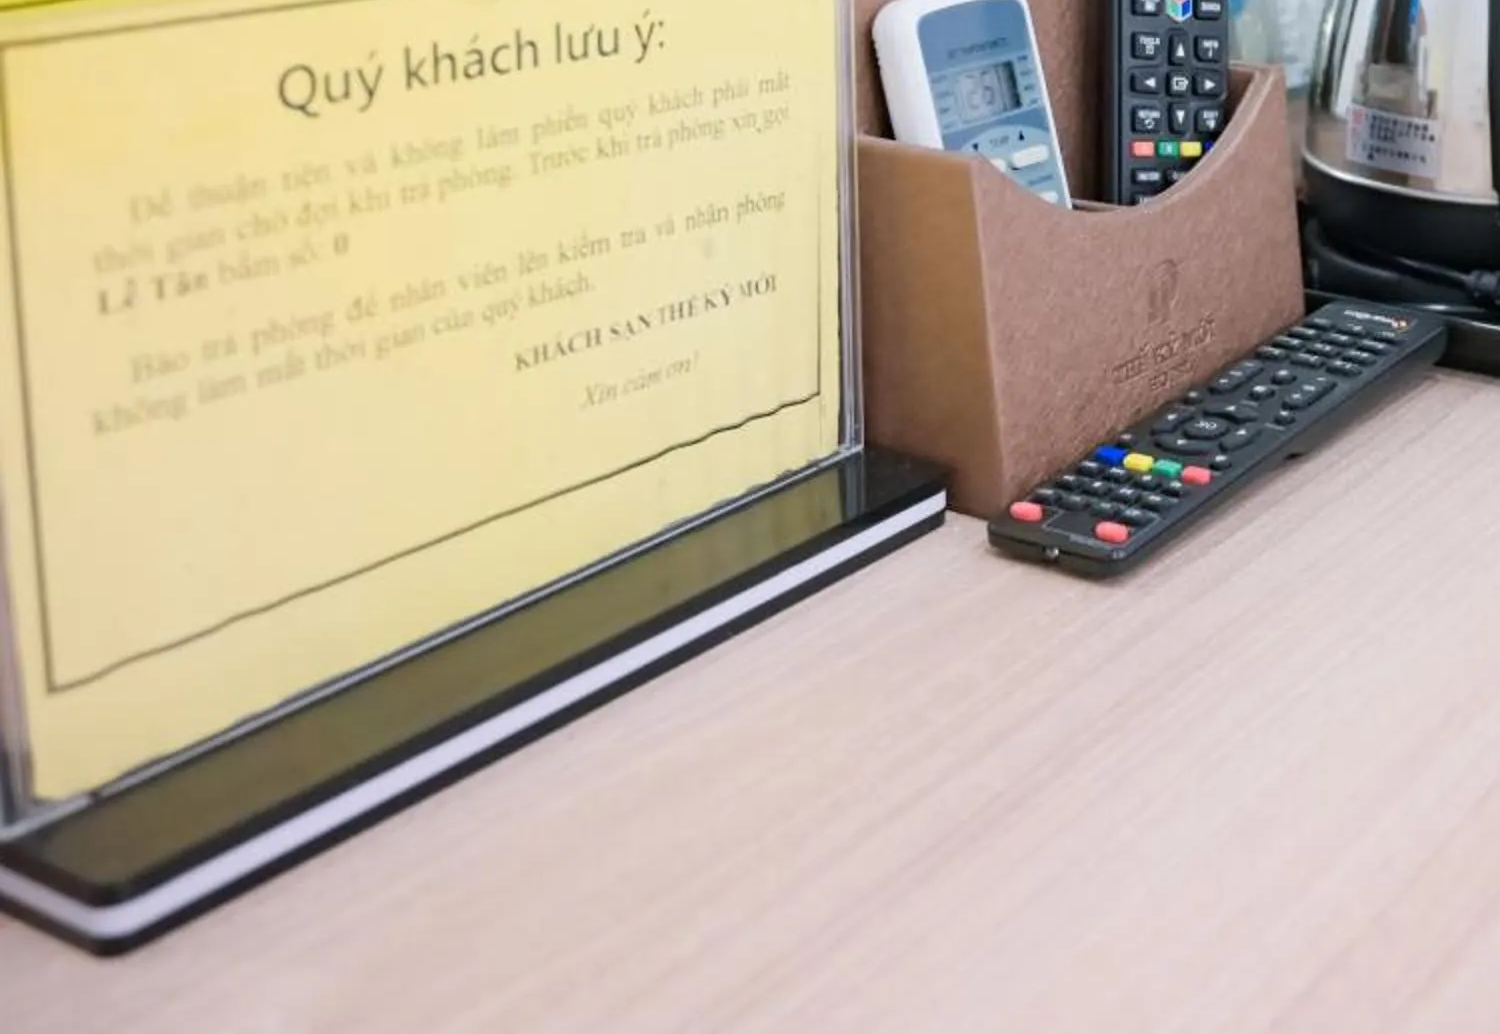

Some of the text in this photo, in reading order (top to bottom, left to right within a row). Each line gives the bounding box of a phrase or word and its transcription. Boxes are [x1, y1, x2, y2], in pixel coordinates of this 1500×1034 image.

[278, 9, 666, 118] Quý khách lưu ý:
[648, 83, 704, 116] khách
[514, 322, 603, 373] KHÁCH
